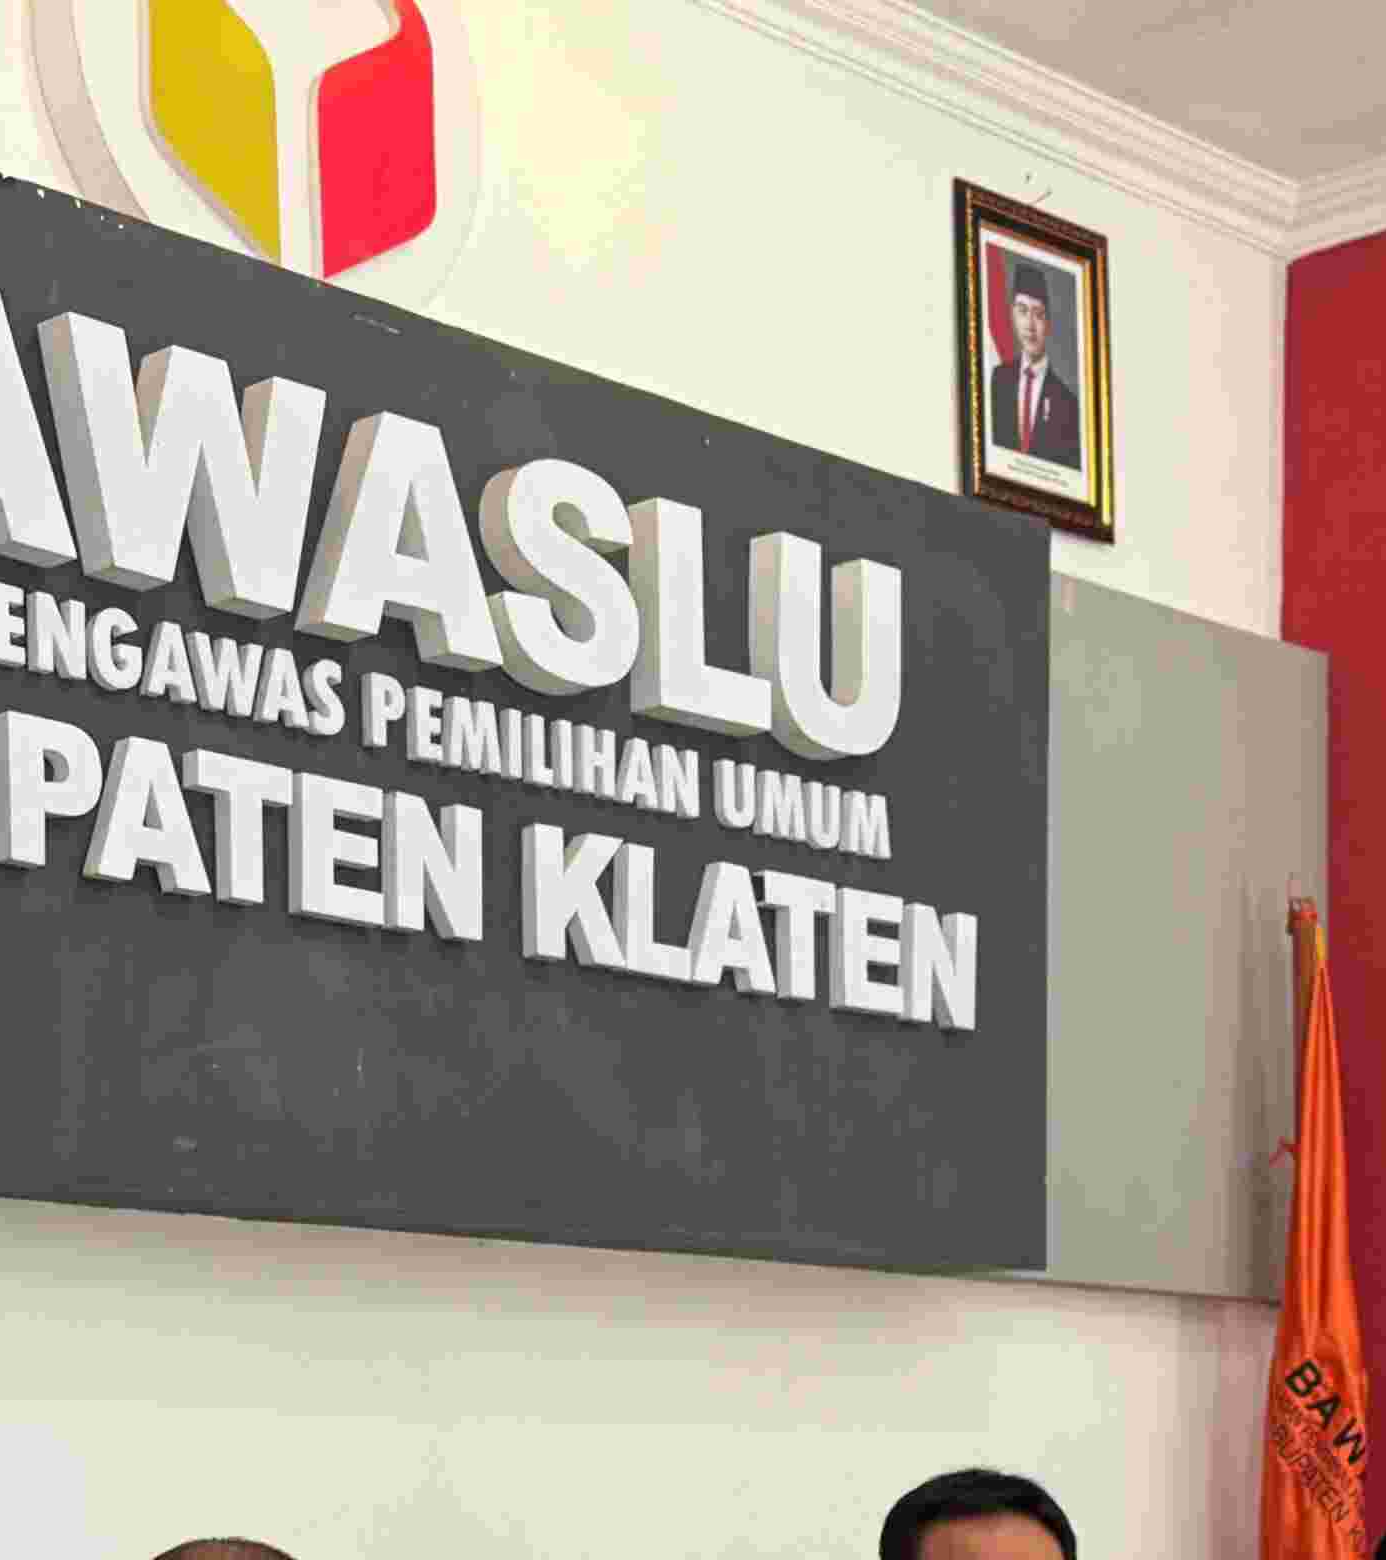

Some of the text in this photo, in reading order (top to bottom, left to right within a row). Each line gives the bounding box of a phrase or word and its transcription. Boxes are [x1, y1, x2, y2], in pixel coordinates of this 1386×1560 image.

[363, 673, 700, 819] PEMILIHAN
[715, 760, 891, 860] UMUM
[520, 824, 978, 1032] KLATEN
